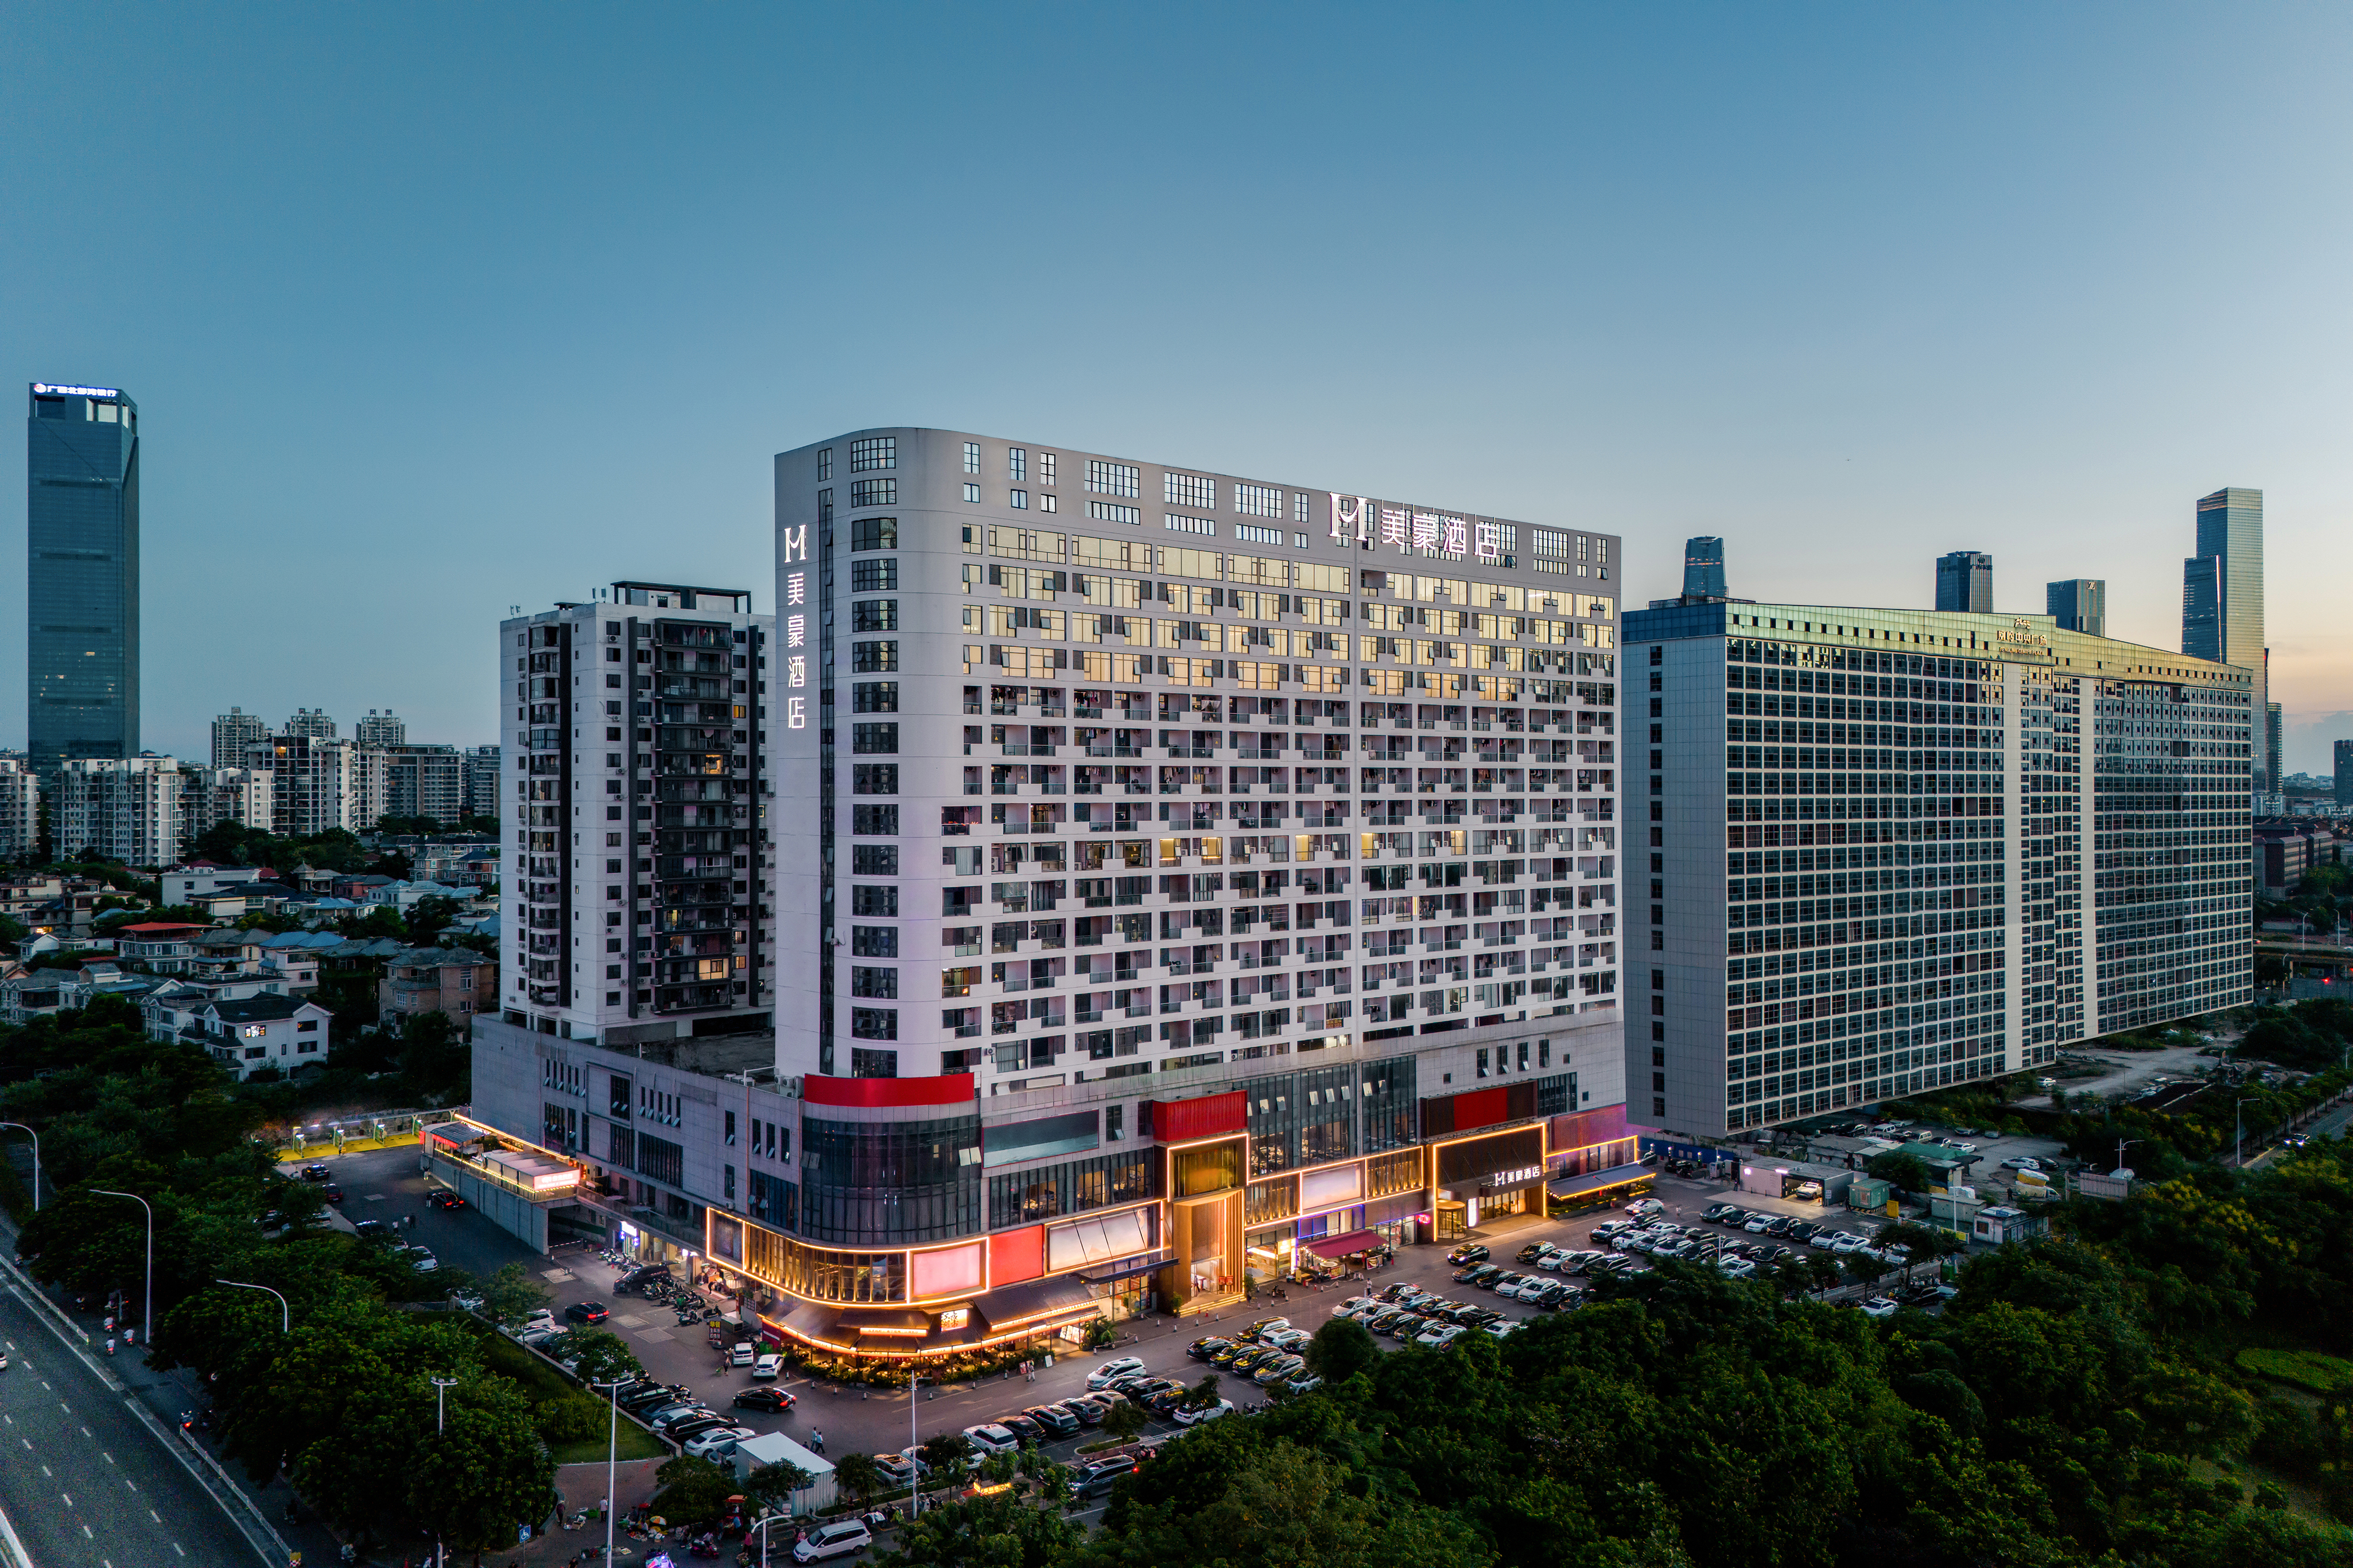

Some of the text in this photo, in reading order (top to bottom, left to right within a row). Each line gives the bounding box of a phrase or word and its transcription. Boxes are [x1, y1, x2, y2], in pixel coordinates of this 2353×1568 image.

[47, 386, 117, 397] 广西北部湾银行
[1381, 509, 1497, 558] 美豪酒店
[1997, 630, 2047, 646] 凤岭中央广场
[788, 572, 805, 729] 美豪酒店
[1507, 1166, 1540, 1184] 美豪酒店
